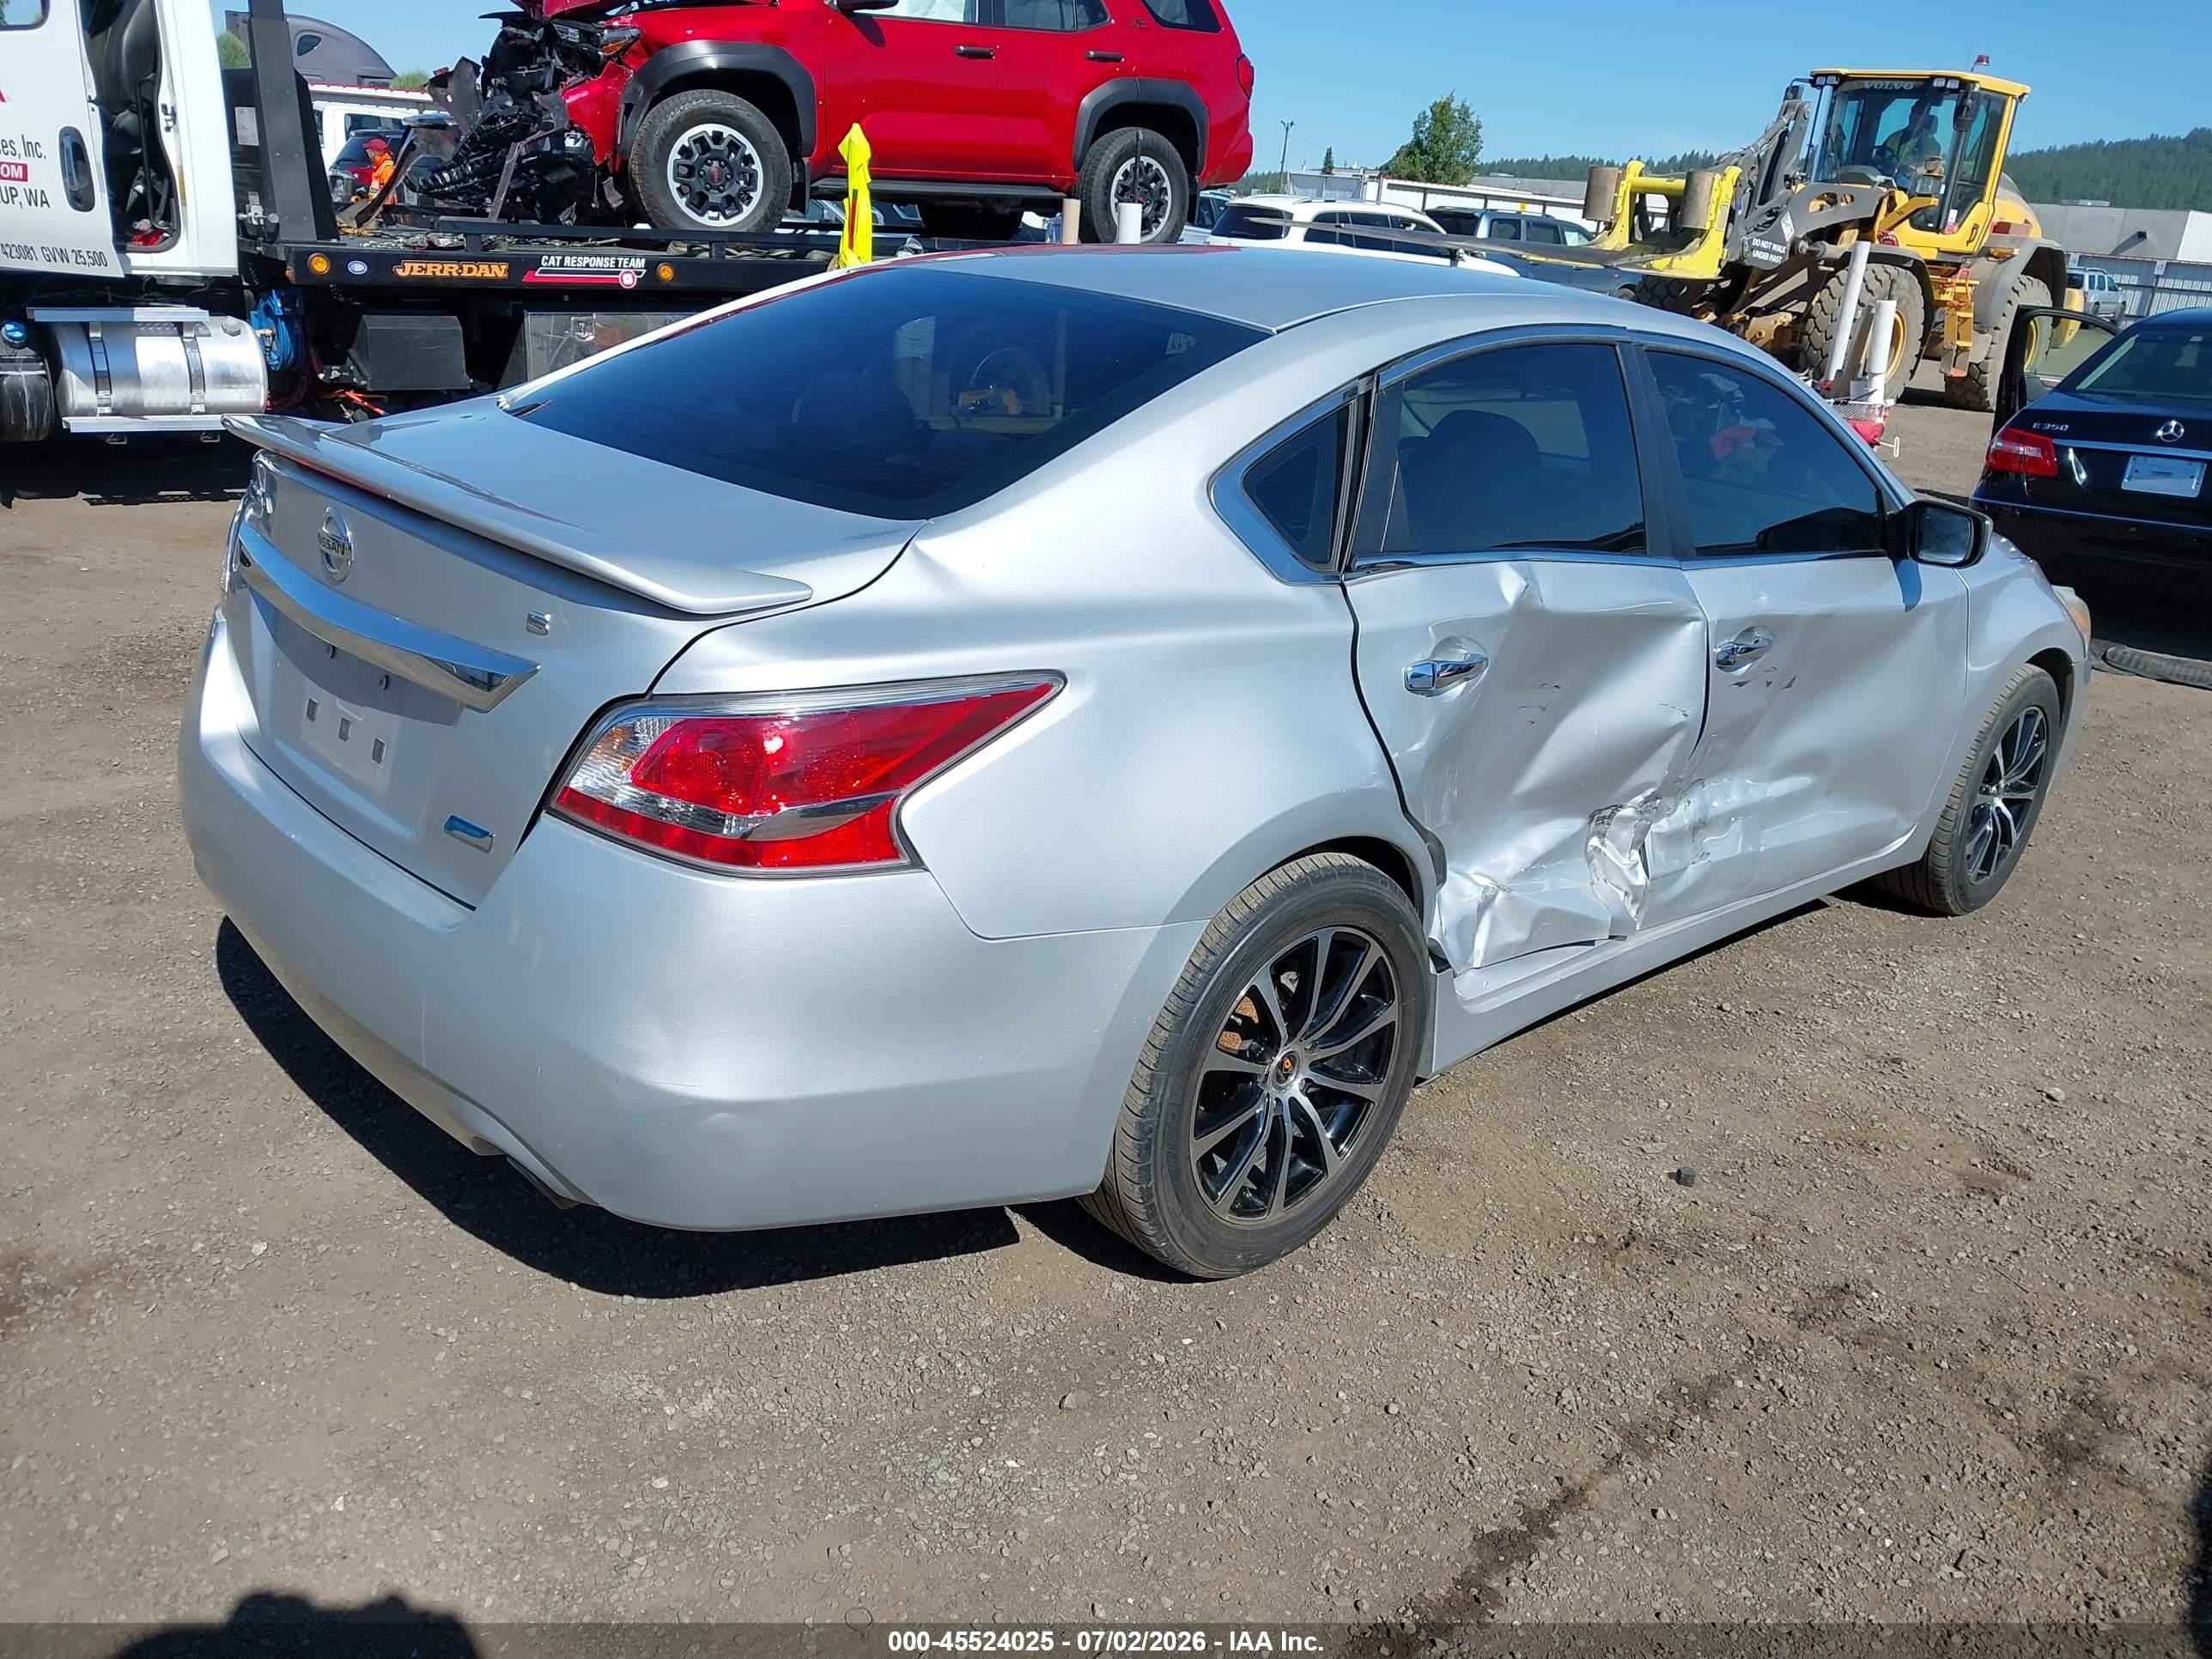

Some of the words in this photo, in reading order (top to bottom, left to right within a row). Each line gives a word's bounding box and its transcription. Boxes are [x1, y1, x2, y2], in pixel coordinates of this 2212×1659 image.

[1863, 81, 1914, 90] VOLVO
[0, 138, 21, 161] es,
[21, 133, 47, 160] Inc.
[0, 185, 23, 210] UP,
[23, 187, 51, 208] WA
[1752, 237, 1761, 246] DO
[1760, 240, 1772, 250] NOT
[1771, 243, 1787, 254] WALK
[40, 246, 70, 264] GVW
[71, 248, 108, 268] 25,500
[541, 255, 562, 267] CAT
[563, 256, 616, 269] RESPONSE
[617, 258, 646, 269] TEAM
[1752, 249, 1770, 262] UNDER
[526, 611, 551, 636] S
